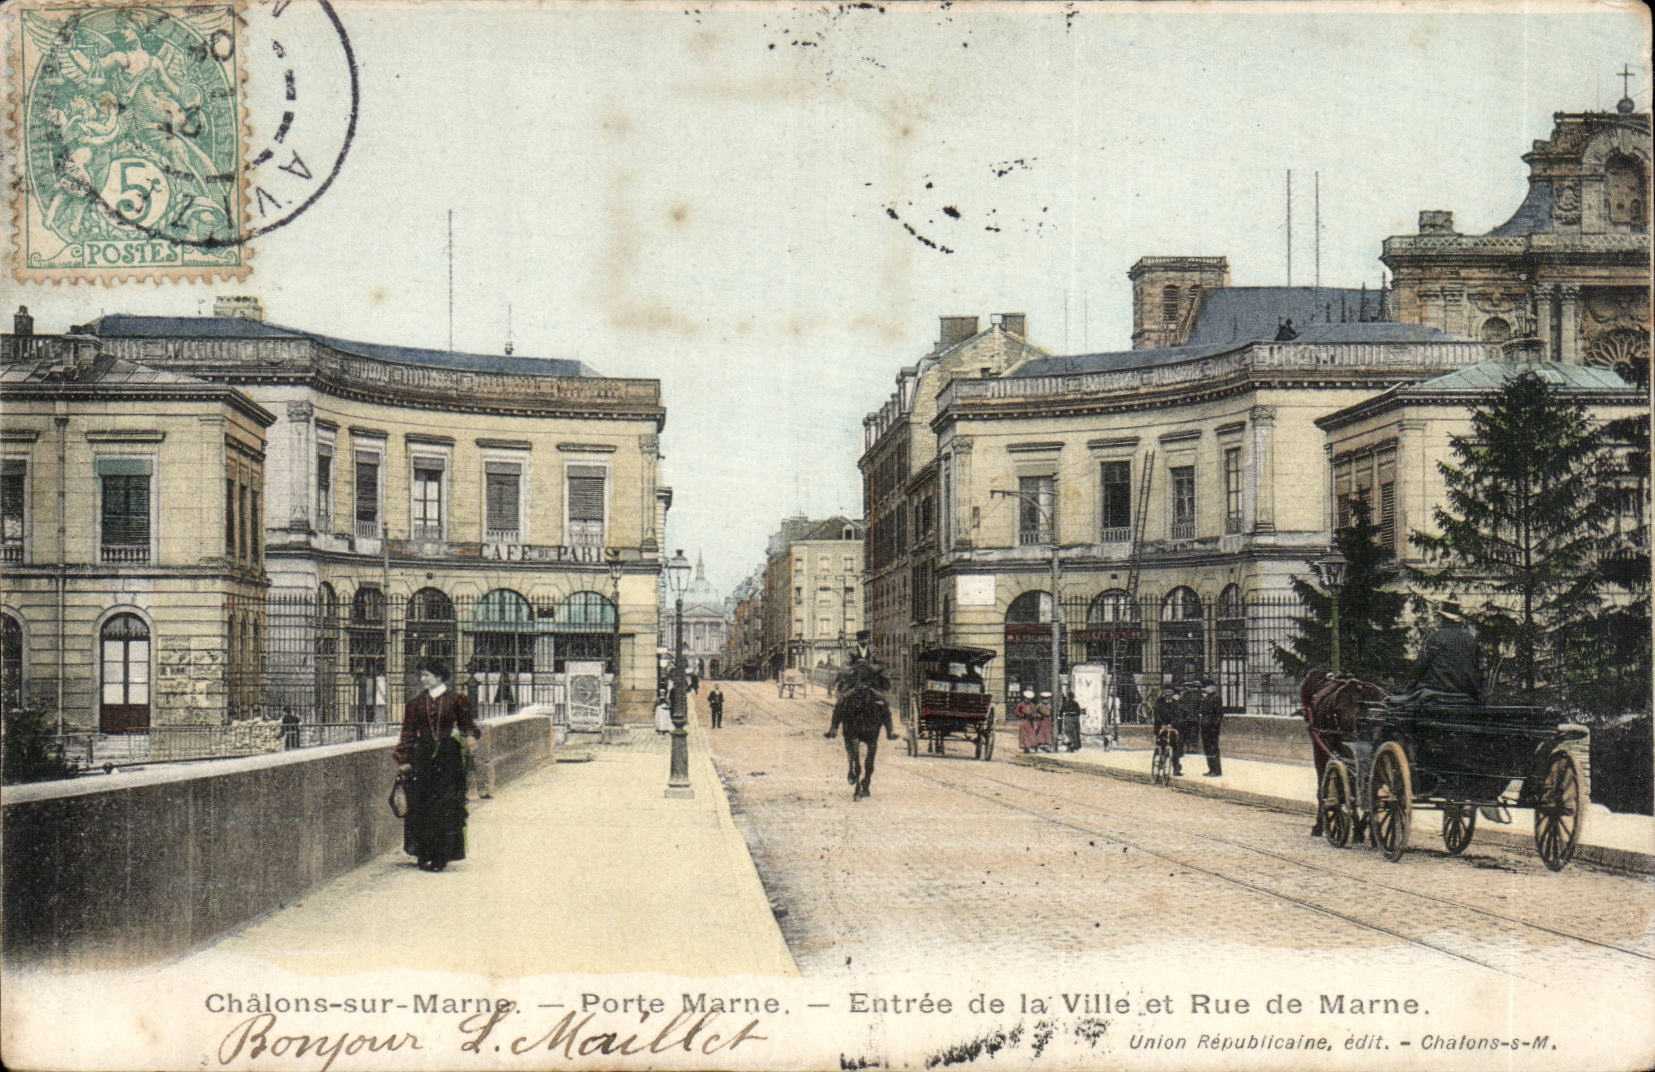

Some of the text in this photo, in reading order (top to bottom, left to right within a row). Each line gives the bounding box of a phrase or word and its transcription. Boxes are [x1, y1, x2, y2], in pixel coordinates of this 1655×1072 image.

[86, 242, 178, 266] POSTES
[538, 548, 553, 559] DE
[218, 1013, 423, 1072] Bonjour
